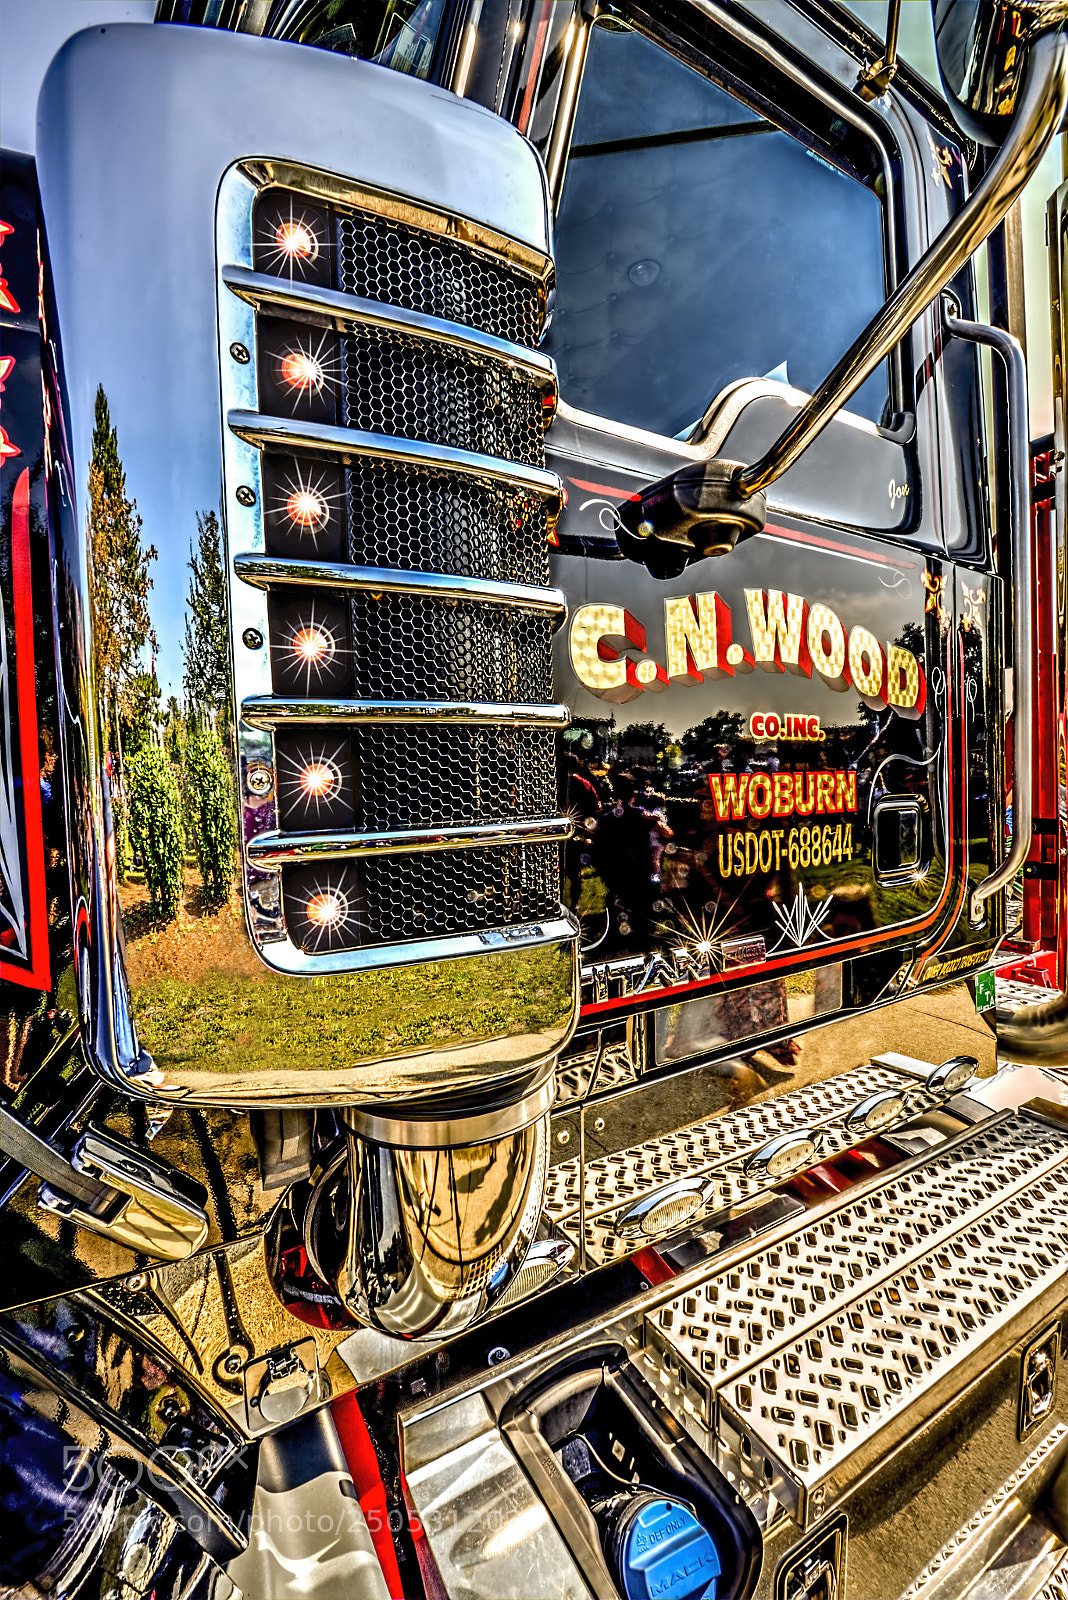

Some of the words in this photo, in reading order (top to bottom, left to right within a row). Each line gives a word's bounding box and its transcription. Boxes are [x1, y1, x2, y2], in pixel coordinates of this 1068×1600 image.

[708, 771, 858, 821] WOBURN
[718, 823, 854, 878] USDOT-688644
[580, 945, 711, 1005] ITAN
[648, 1529, 665, 1545] DEF
[665, 1515, 686, 1535] ONLY
[650, 1552, 716, 1597] MACK
